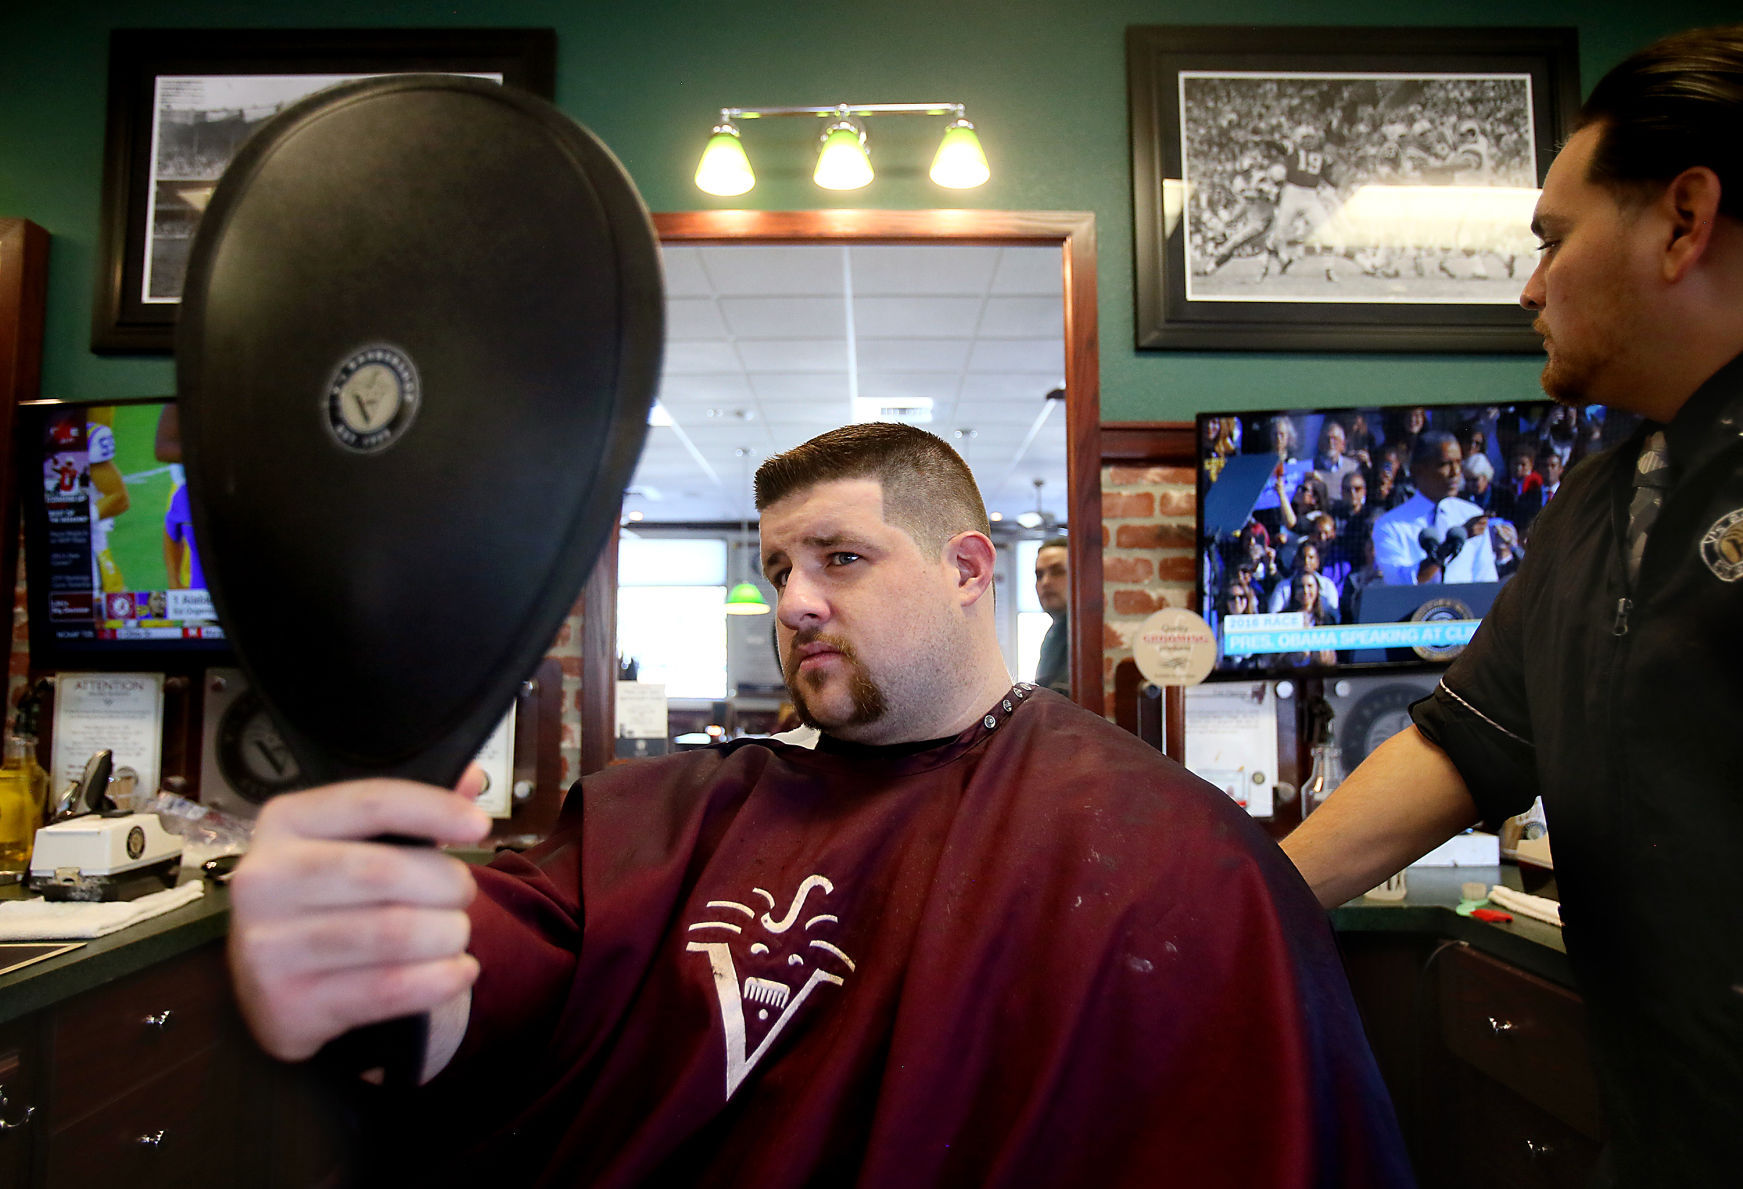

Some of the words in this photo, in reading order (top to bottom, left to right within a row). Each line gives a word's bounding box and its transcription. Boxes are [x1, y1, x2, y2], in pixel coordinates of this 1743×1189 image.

[1230, 616, 1260, 629] 2016
[1263, 613, 1300, 628] RACE
[1230, 634, 1274, 650] PRES.
[1278, 630, 1338, 648] OBAMA
[1341, 627, 1420, 645] SPEAKING
[1422, 627, 1443, 641] AT
[74, 680, 144, 690] ATTENTION
